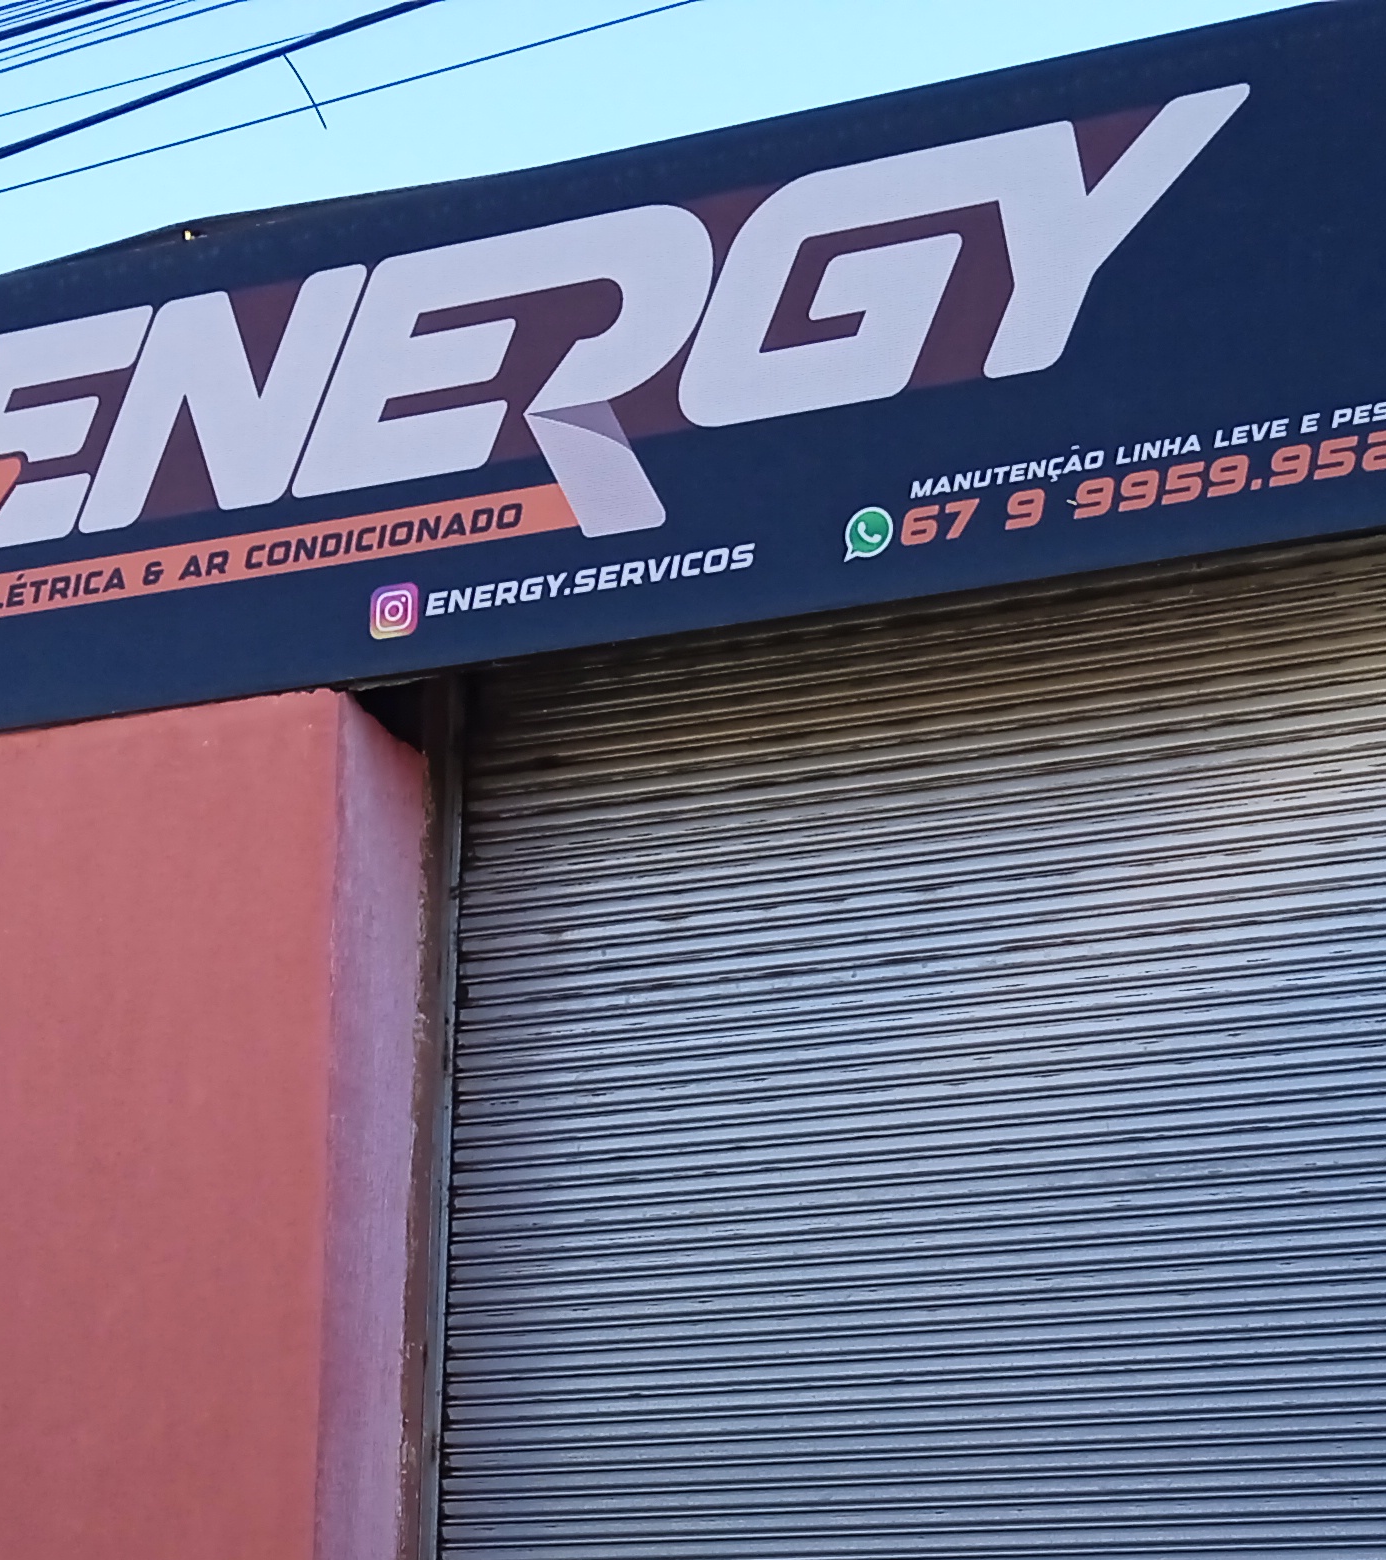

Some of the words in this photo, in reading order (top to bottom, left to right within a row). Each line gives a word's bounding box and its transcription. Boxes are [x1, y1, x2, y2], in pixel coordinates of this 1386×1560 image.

[909, 445, 1105, 499] MANUTENÇÃO
[1116, 433, 1202, 466] LINHA
[1214, 418, 1289, 448] LEVE
[1300, 413, 1320, 434] E
[142, 560, 164, 586] &
[178, 549, 229, 582] AR
[244, 502, 523, 569] CONDICIONADO
[900, 498, 980, 546] 67
[1004, 488, 1045, 530] 9
[424, 542, 756, 618] ENERGY.SERVICOS
